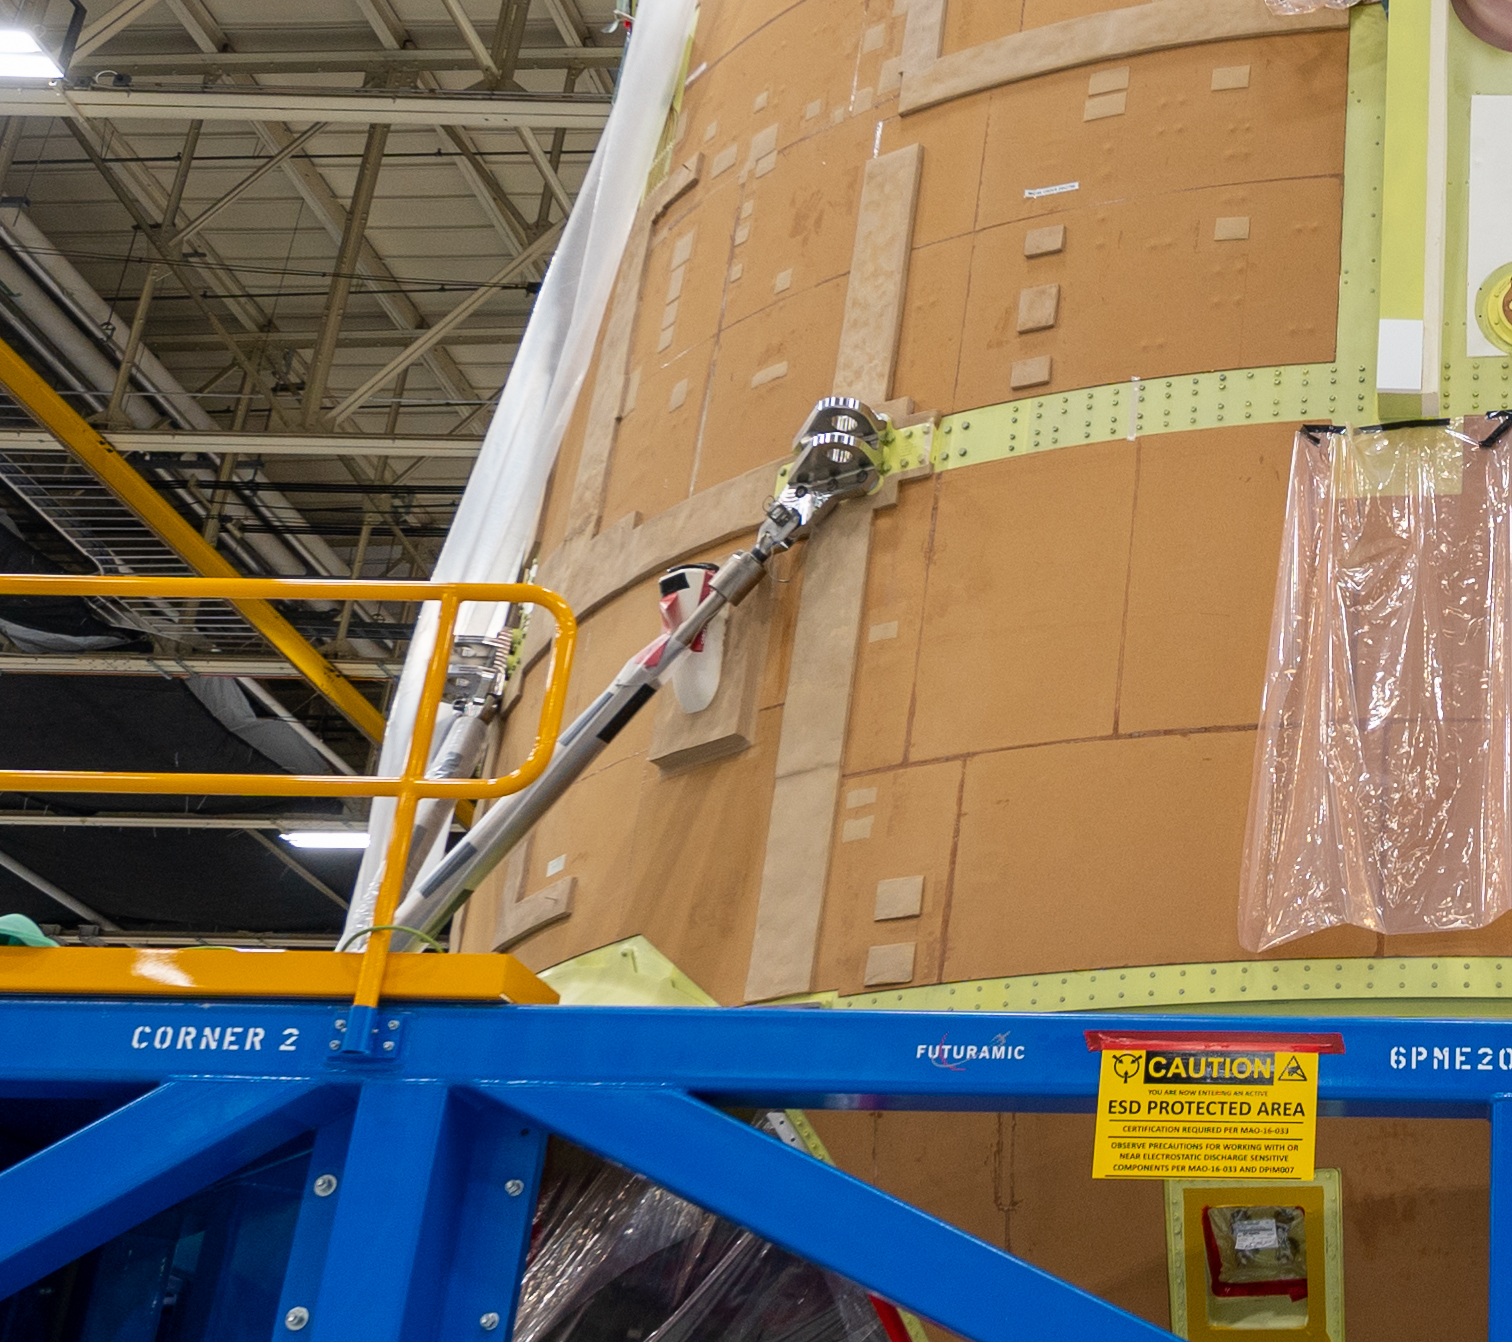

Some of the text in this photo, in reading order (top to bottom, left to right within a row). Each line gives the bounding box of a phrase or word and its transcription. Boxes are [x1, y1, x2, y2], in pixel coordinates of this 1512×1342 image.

[132, 1026, 299, 1051] CORNER 2
[916, 1044, 1025, 1060] FUTURAMIC
[1148, 1057, 1271, 1079] CAUTION
[1108, 1100, 1306, 1117] ESD PROTECTED AREA
[1122, 1125, 1180, 1134] CERTIFICATION
[1182, 1126, 1222, 1134] REQUIRED
[1111, 1142, 1299, 1152] OBSERVE PRECAUTIONS FOR WORKING WITH OR
[1143, 1153, 1201, 1161] ELECTROSTATIC
[1204, 1154, 1248, 1162] DISCHARGE
[1250, 1154, 1289, 1162] SENSITIVE
[1113, 1164, 1169, 1172] COMPONENTS
[1171, 1164, 1186, 1172] PER
